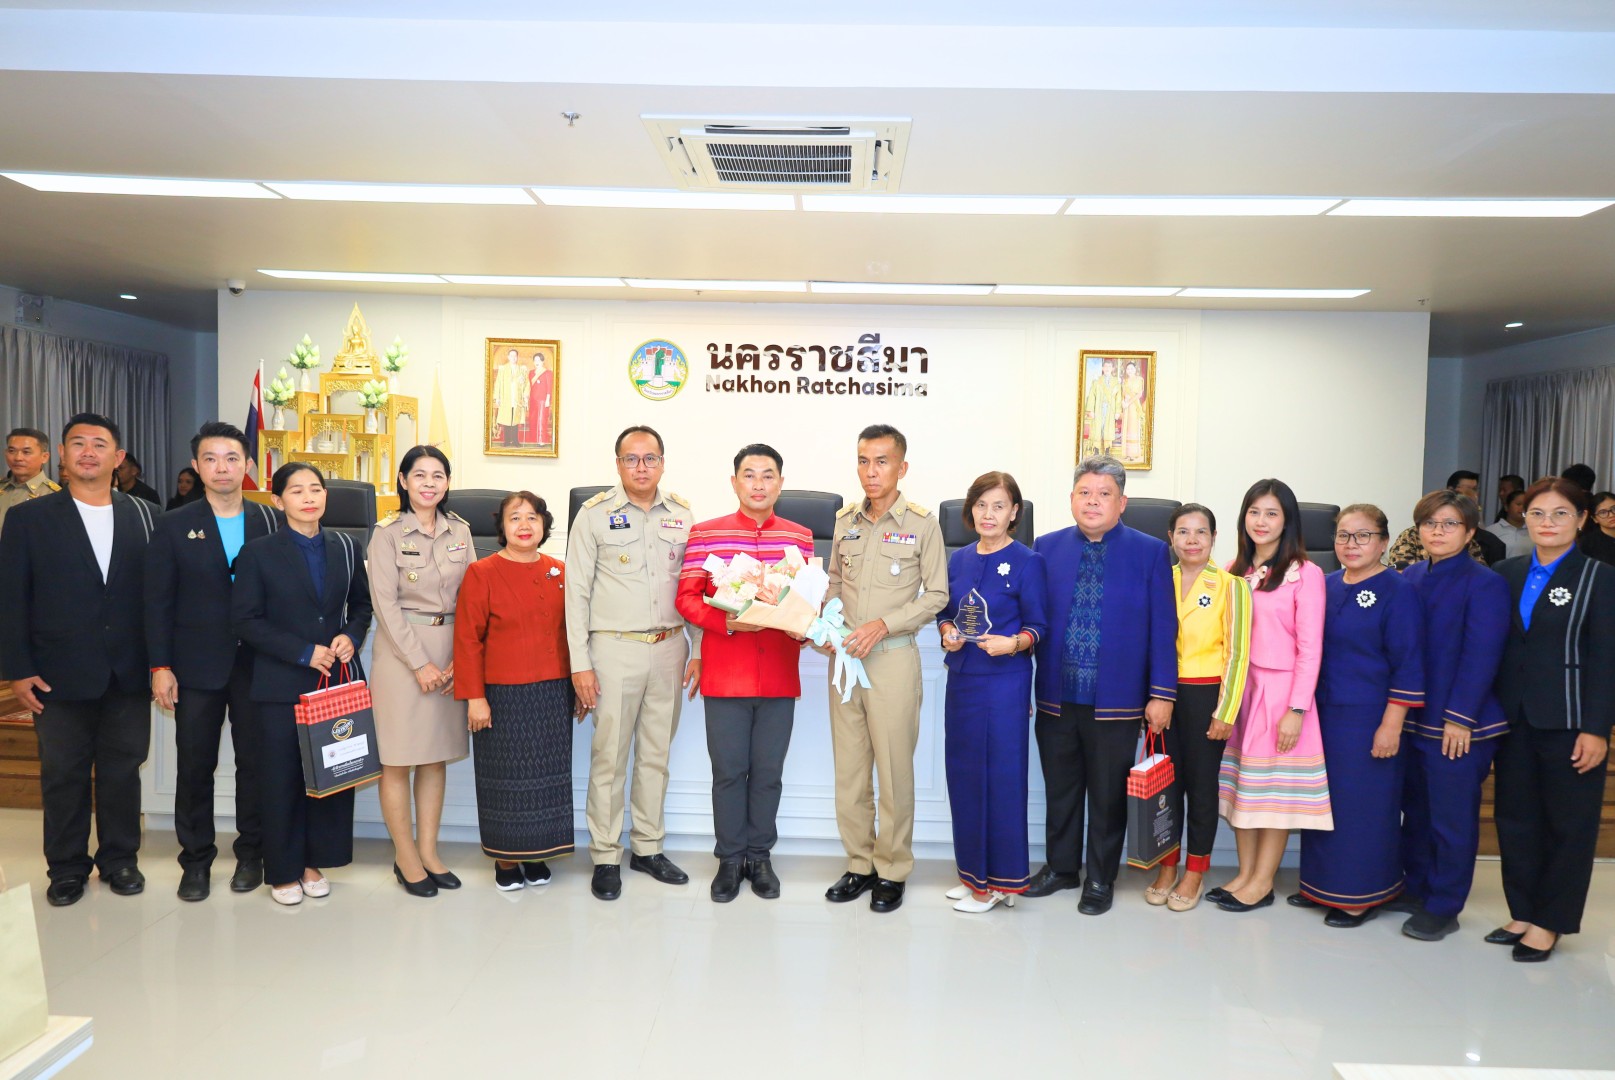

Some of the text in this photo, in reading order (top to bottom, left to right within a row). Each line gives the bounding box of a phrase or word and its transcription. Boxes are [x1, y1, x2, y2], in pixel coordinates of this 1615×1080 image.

[706, 333, 928, 373] นครราชสีมา
[705, 374, 928, 397] Nakhon Ratchasima
